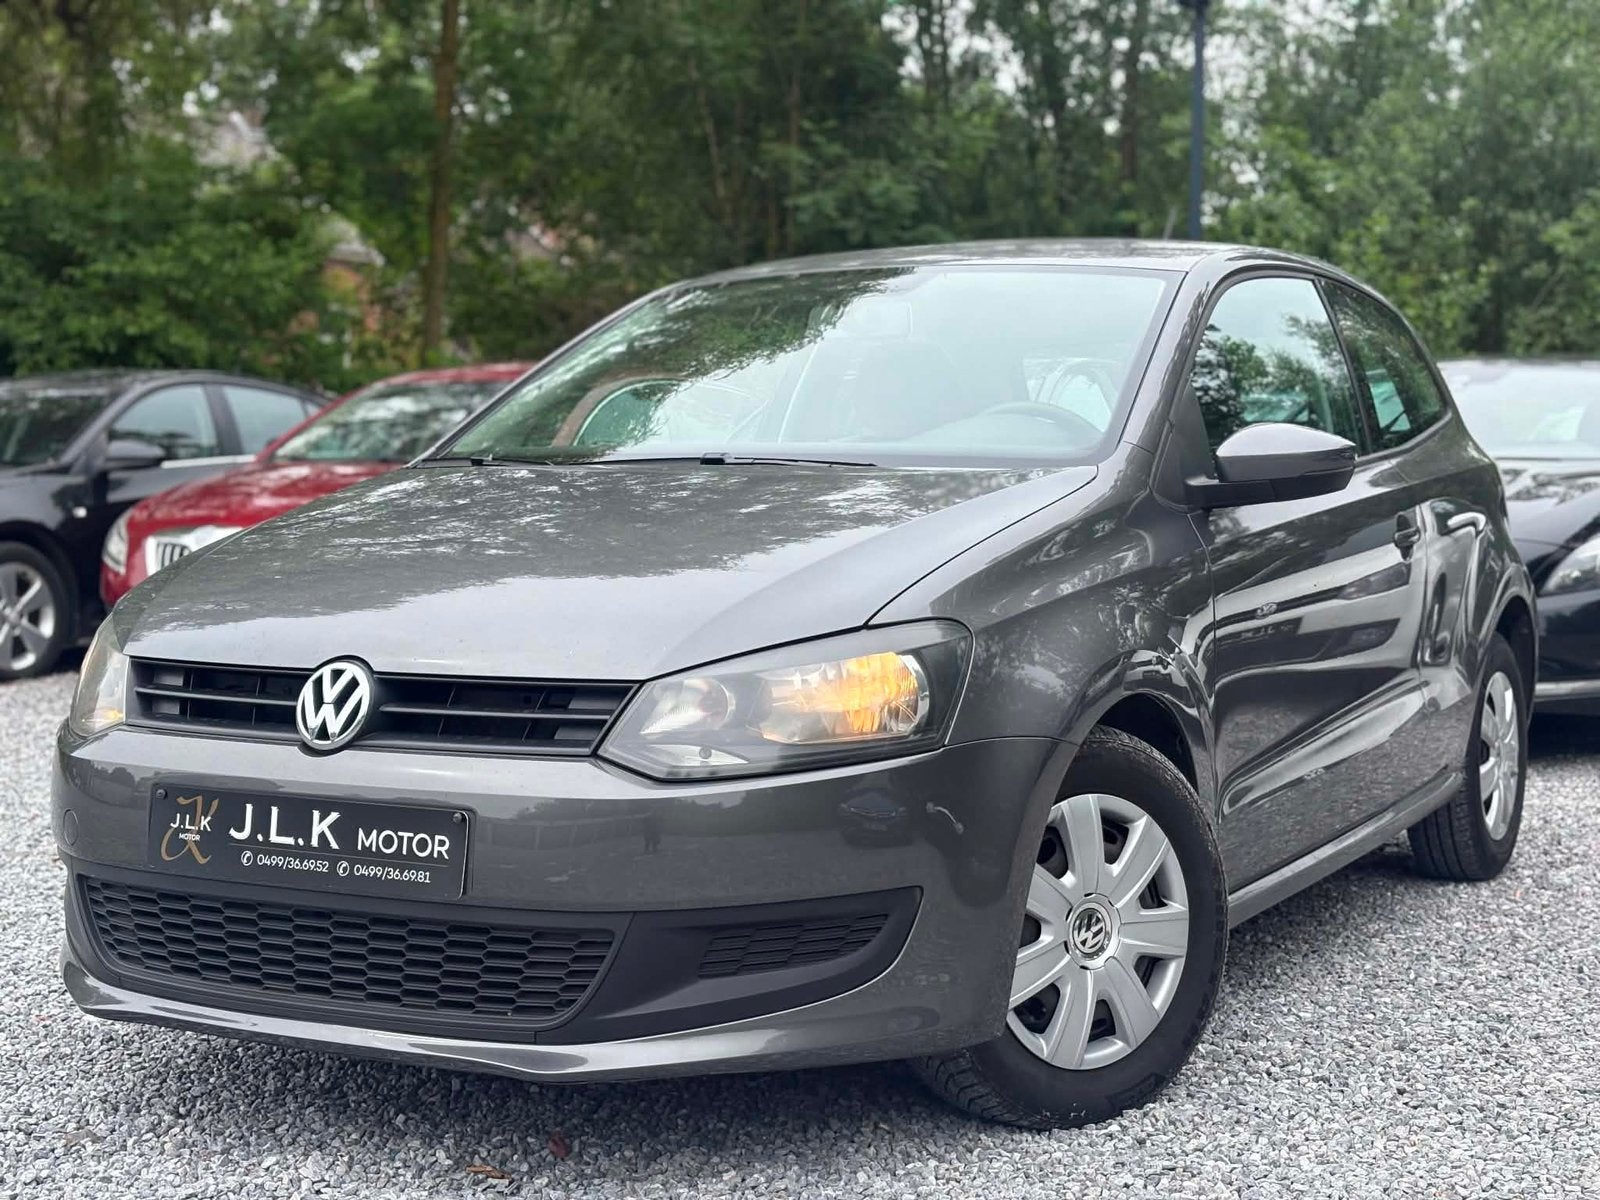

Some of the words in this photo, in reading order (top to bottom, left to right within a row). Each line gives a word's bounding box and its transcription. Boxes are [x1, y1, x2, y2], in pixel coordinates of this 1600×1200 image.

[299, 664, 369, 746] VW
[169, 812, 213, 832] J.L.K
[228, 803, 341, 850] J.L.K
[357, 827, 450, 860] MOTOR
[178, 832, 201, 842] MOTOR
[257, 854, 329, 873] 0499/36.69.52
[353, 864, 431, 884] 0499/36.69.81
